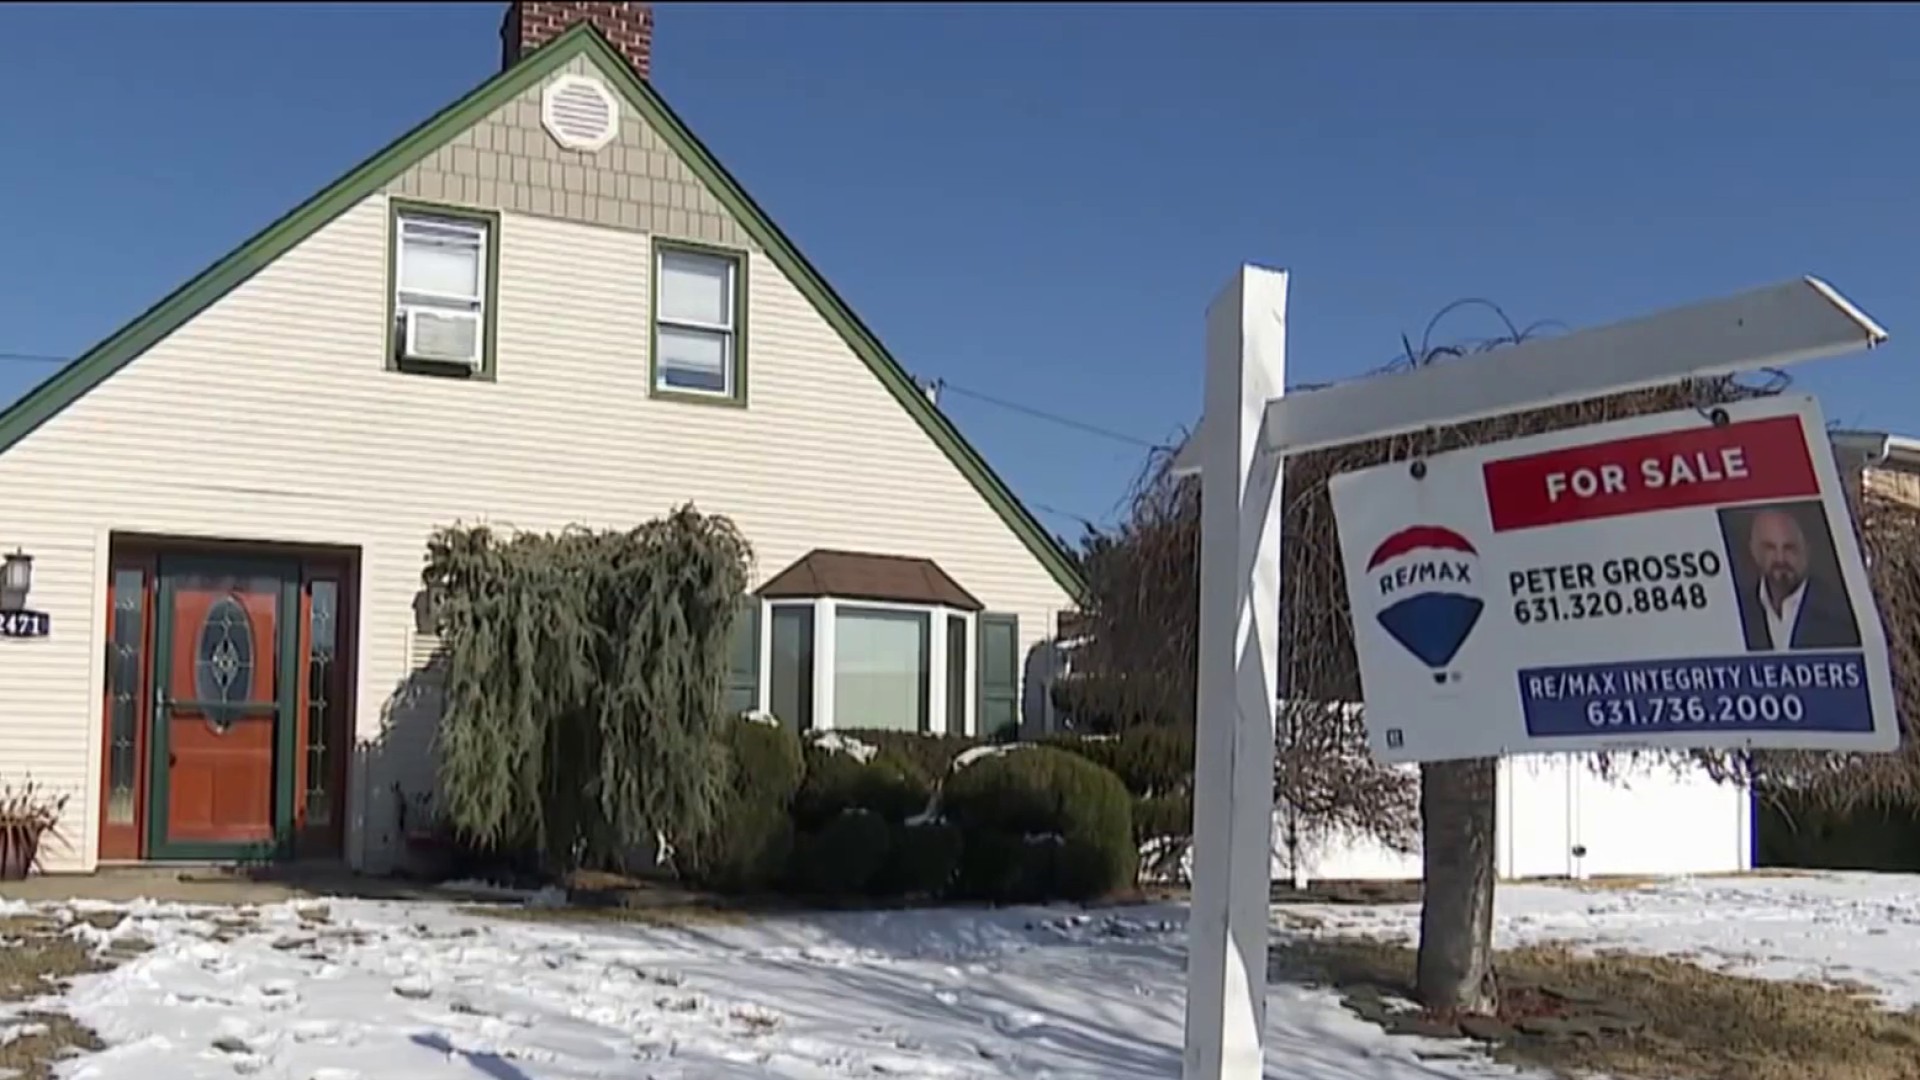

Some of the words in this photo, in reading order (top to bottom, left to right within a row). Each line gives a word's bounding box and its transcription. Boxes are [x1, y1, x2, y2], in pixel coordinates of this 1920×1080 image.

[1546, 464, 1626, 502] FOR
[1641, 447, 1748, 487] SALE
[1380, 561, 1471, 595] RE/MAX
[1509, 563, 1595, 597] PETER
[1603, 550, 1720, 585] GROSSO
[1514, 583, 1707, 624] 631.320.8848
[1529, 671, 1616, 700] RE/MAX
[1624, 665, 1741, 694] INTEGRITY
[1750, 662, 1860, 689] LEADERS
[1587, 694, 1803, 726] 631.736.2000
